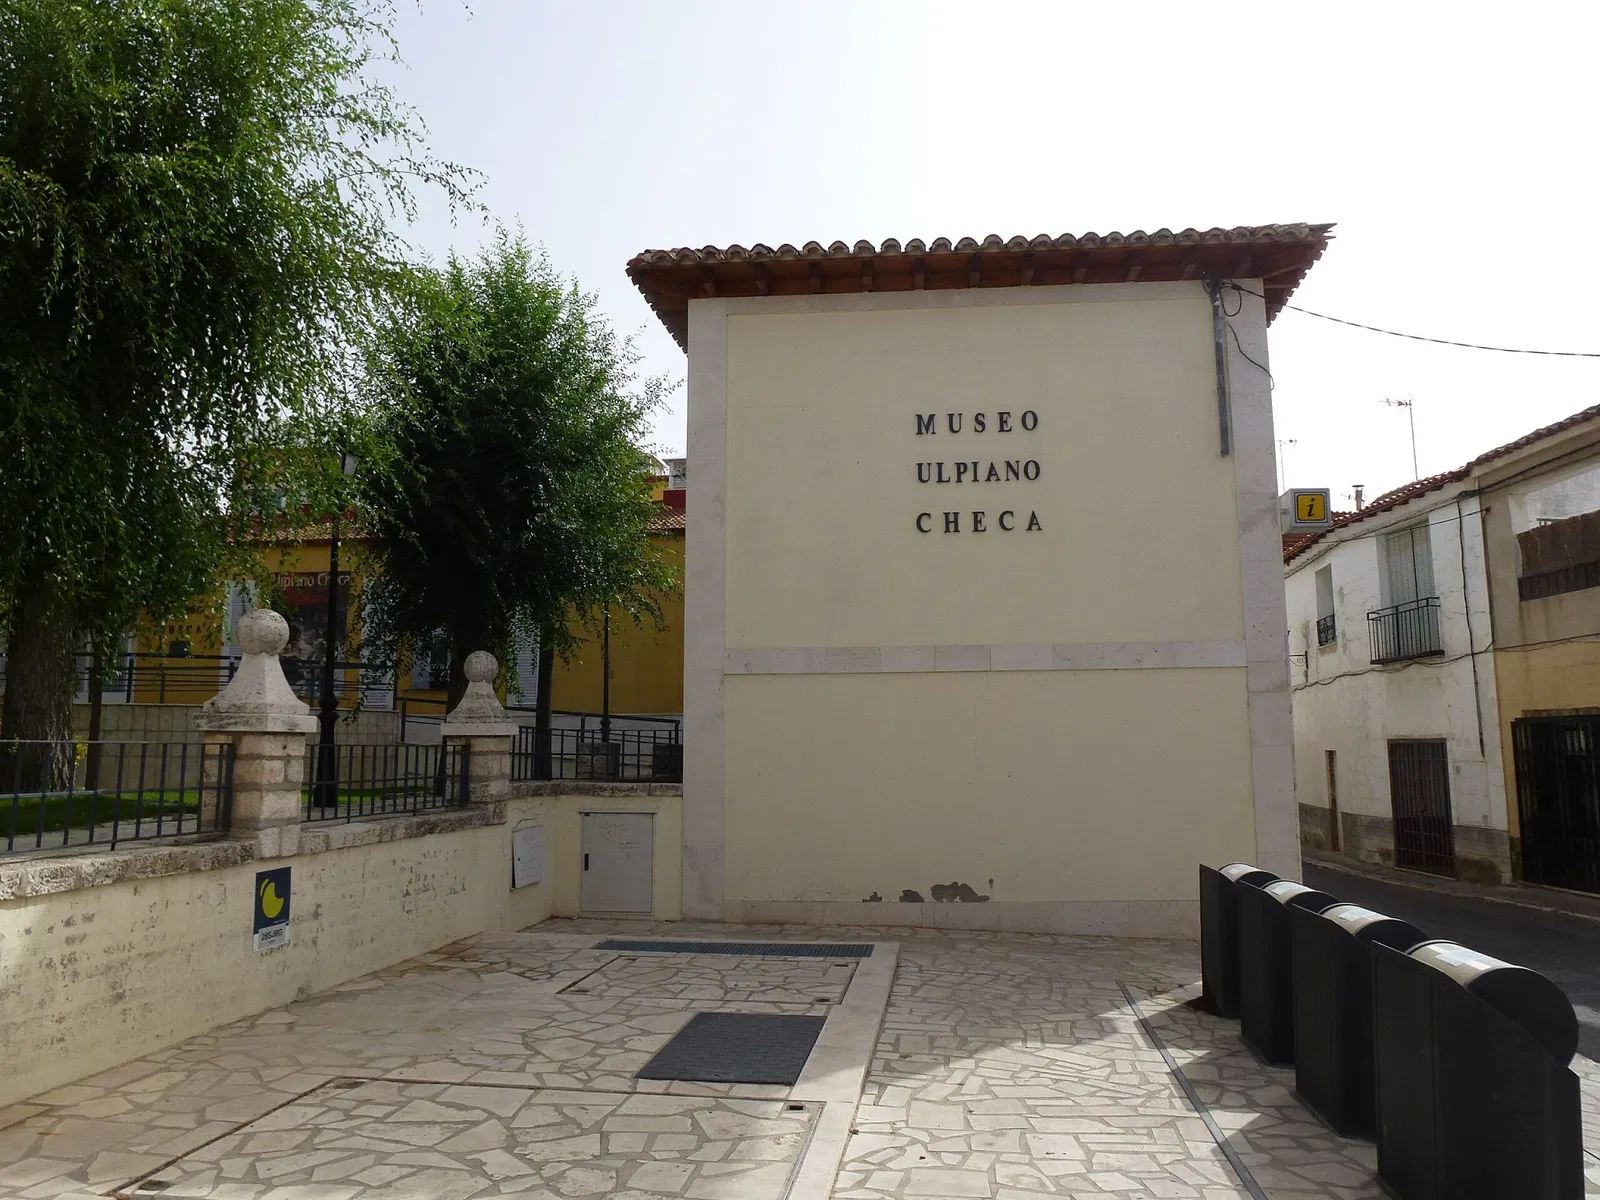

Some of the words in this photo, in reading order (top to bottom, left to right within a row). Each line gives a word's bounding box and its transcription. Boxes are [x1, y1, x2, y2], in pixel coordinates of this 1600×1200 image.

[915, 410, 1039, 435] MUSEO
[915, 459, 1041, 483] ULPIANO
[915, 510, 1042, 533] CHECA
[317, 571, 351, 587] Chca
